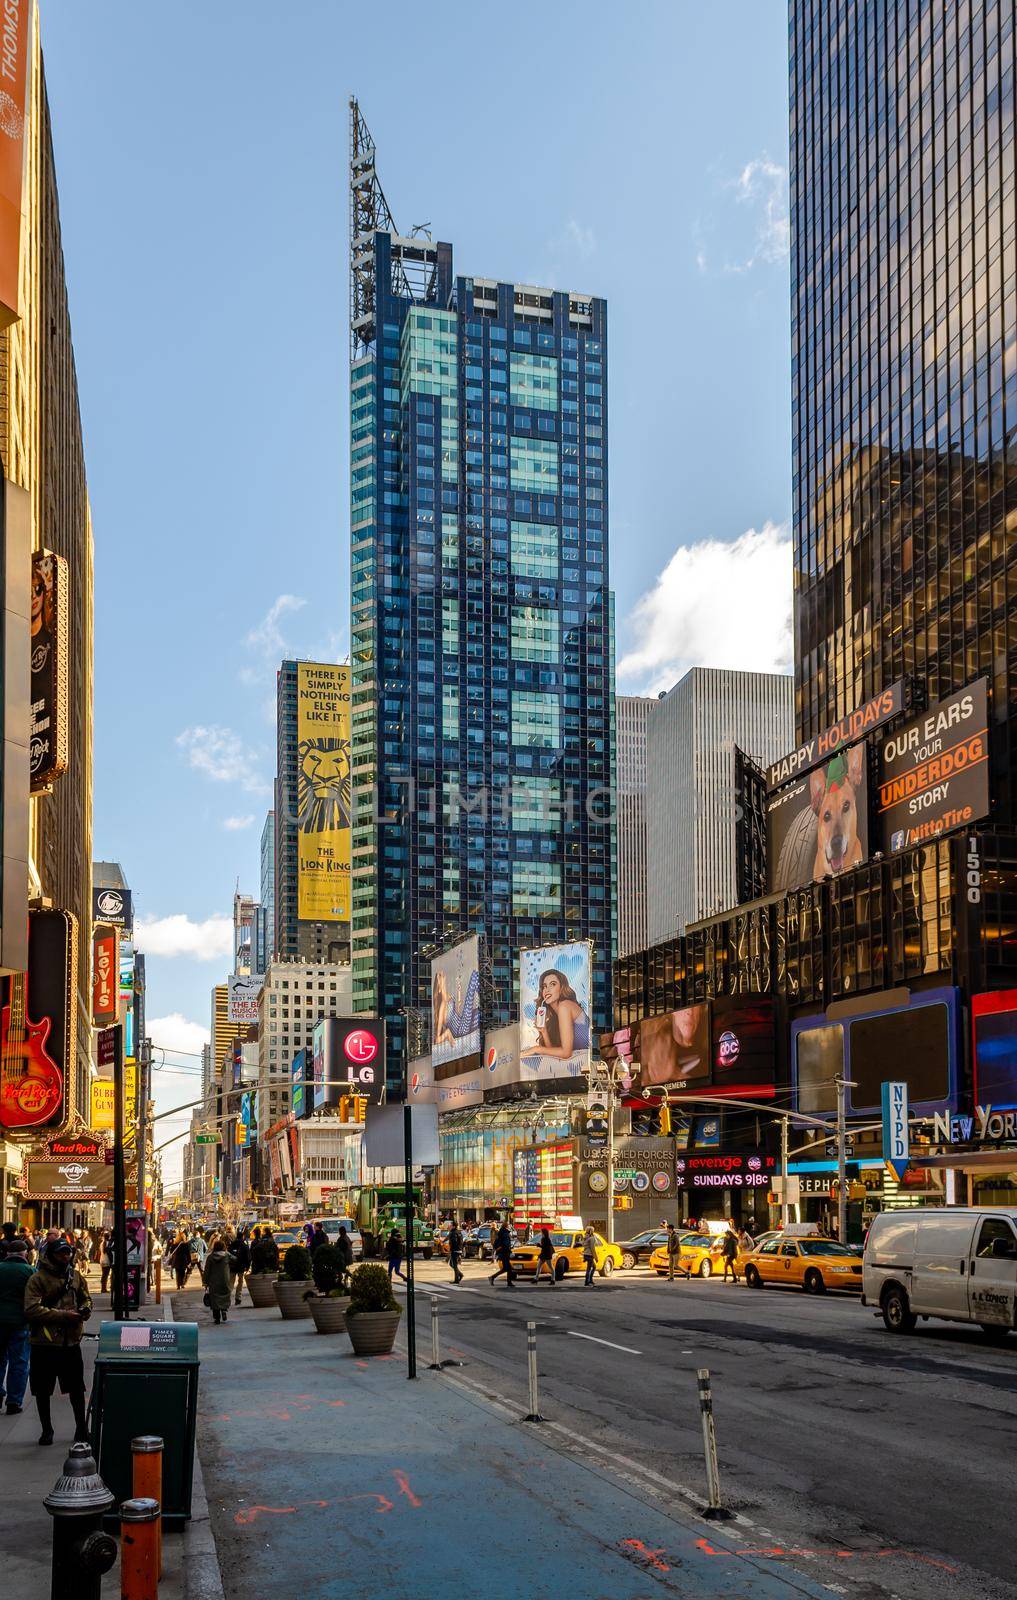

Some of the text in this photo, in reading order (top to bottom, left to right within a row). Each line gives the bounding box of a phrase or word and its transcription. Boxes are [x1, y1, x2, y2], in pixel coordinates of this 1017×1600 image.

[337, 672, 347, 681] IS
[307, 680, 343, 691] SIMPLY
[300, 690, 350, 702] NOTHING
[314, 702, 337, 712] ELSE
[306, 711, 329, 721] LIKE
[884, 695, 974, 763] OUR EARS
[771, 689, 894, 784] HAPPY HOLIDAYS
[913, 738, 942, 763] YOUR
[881, 738, 983, 806] UNDERDOG
[908, 782, 950, 815] STORY
[317, 847, 334, 856] THE
[300, 857, 351, 873] LION KING
[966, 837, 981, 904] 1500
[96, 914, 125, 923] Prudential
[347, 1066, 375, 1083] LG
[664, 1080, 687, 1090] SIEMENS
[4, 1083, 58, 1101] Hard Rock
[893, 1086, 904, 1157] NYPD
[975, 1104, 1017, 1140] YOR
[52, 1143, 97, 1155] Hard Rock
[600, 1149, 637, 1159] AMED
[637, 1149, 675, 1160] FORCES
[637, 1160, 670, 1169] STATION
[688, 1156, 742, 1171] revenge
[74, 1166, 89, 1175] Rock
[694, 1174, 742, 1186] SUNDAYS
